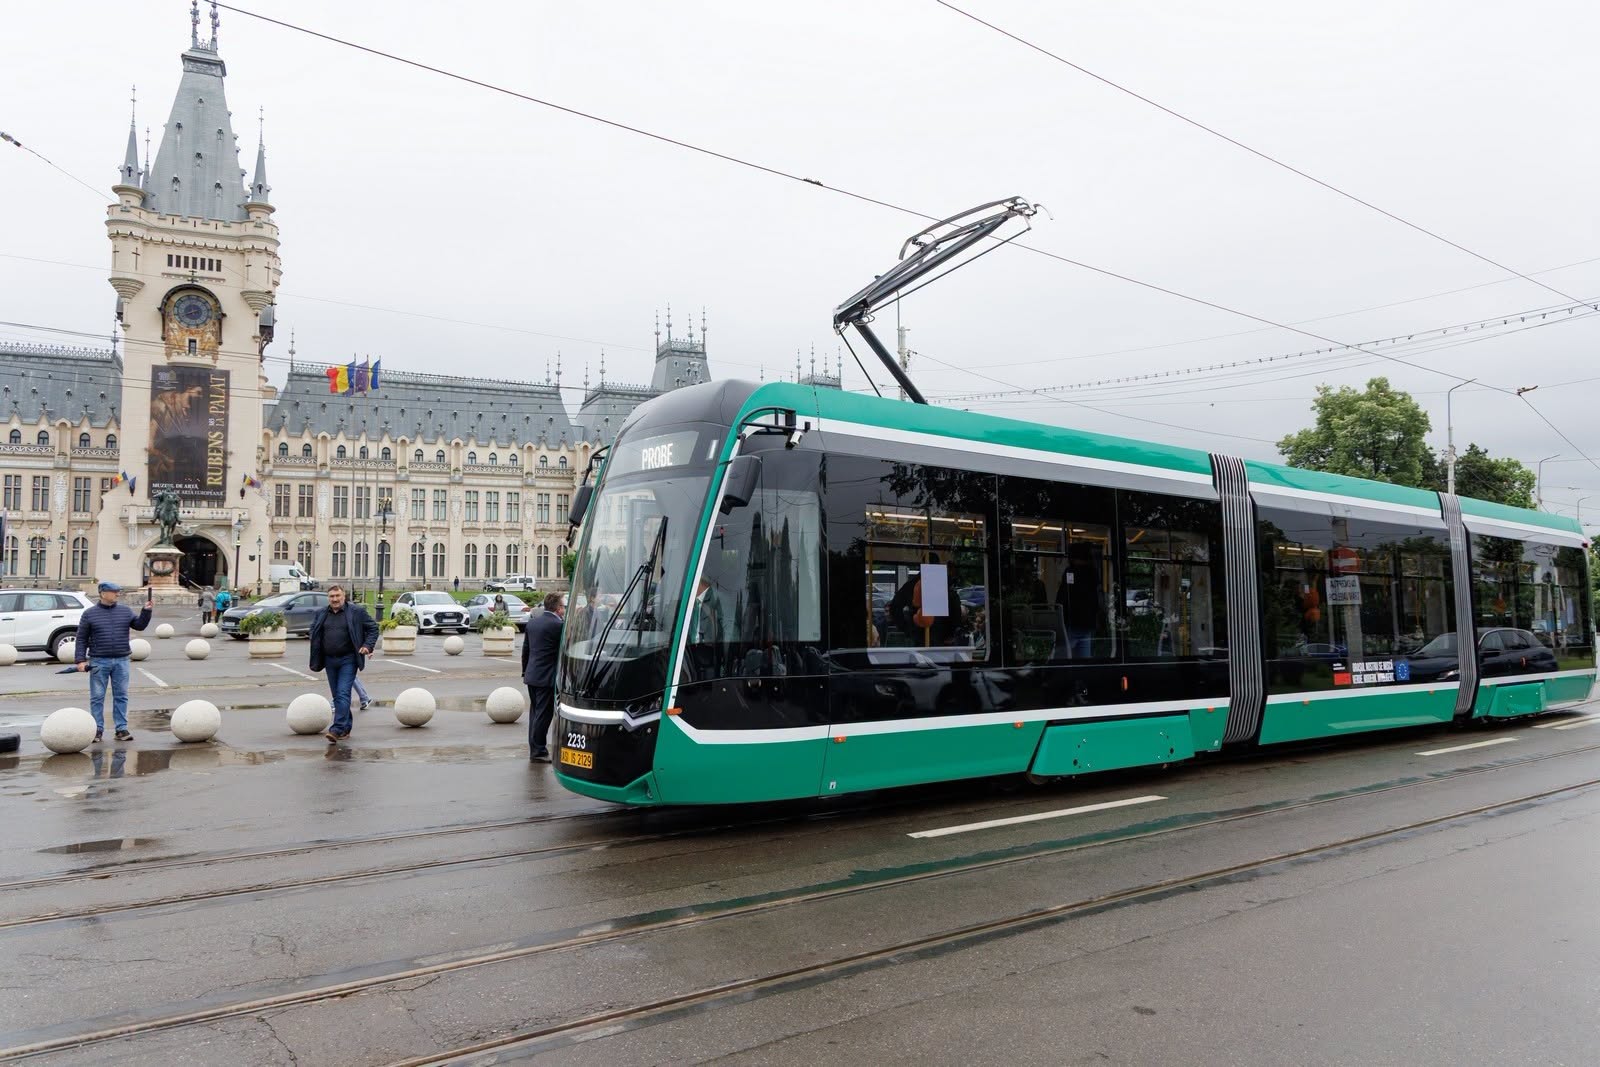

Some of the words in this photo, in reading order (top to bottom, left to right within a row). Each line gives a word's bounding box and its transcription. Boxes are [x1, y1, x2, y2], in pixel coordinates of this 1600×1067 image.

[209, 374, 225, 414] PALAT
[207, 431, 224, 486] RUBENS
[641, 443, 674, 470] PROBE
[567, 732, 586, 749] 2233
[577, 753, 592, 767] 2129
